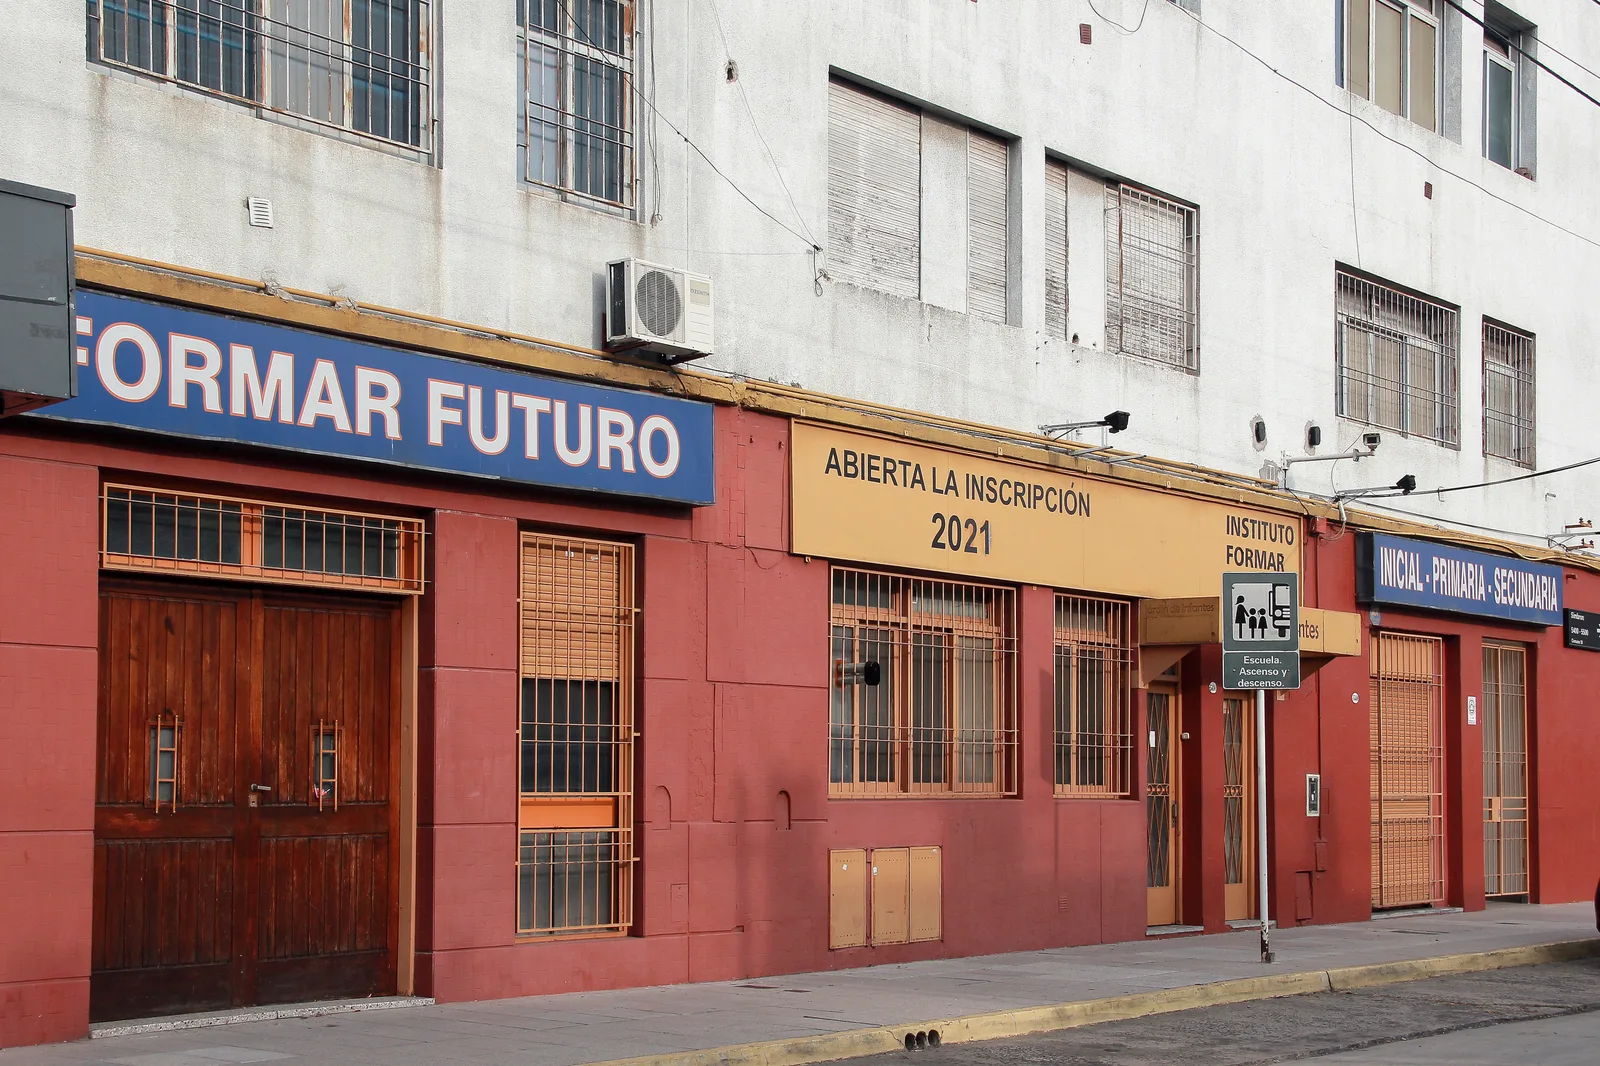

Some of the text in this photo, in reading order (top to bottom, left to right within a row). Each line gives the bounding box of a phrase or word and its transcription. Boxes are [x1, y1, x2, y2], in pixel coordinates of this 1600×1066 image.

[427, 378, 681, 479] FUTURO
[824, 447, 1091, 518] ABIERTA LA INSCRIPCIÓN
[931, 512, 991, 555] 2021
[1226, 514, 1294, 546] INSTITUTO
[1226, 544, 1285, 572] FORMAR
[1380, 546, 1424, 592] INICIAL
[1432, 556, 1486, 601] PRIMARIA
[1494, 566, 1558, 612] SECUNDARIA
[1299, 620, 1319, 639] ntes
[1238, 667, 1288, 677] Ascenso y
[1243, 655, 1282, 664] Escuela.
[1237, 678, 1285, 688] descenso.
